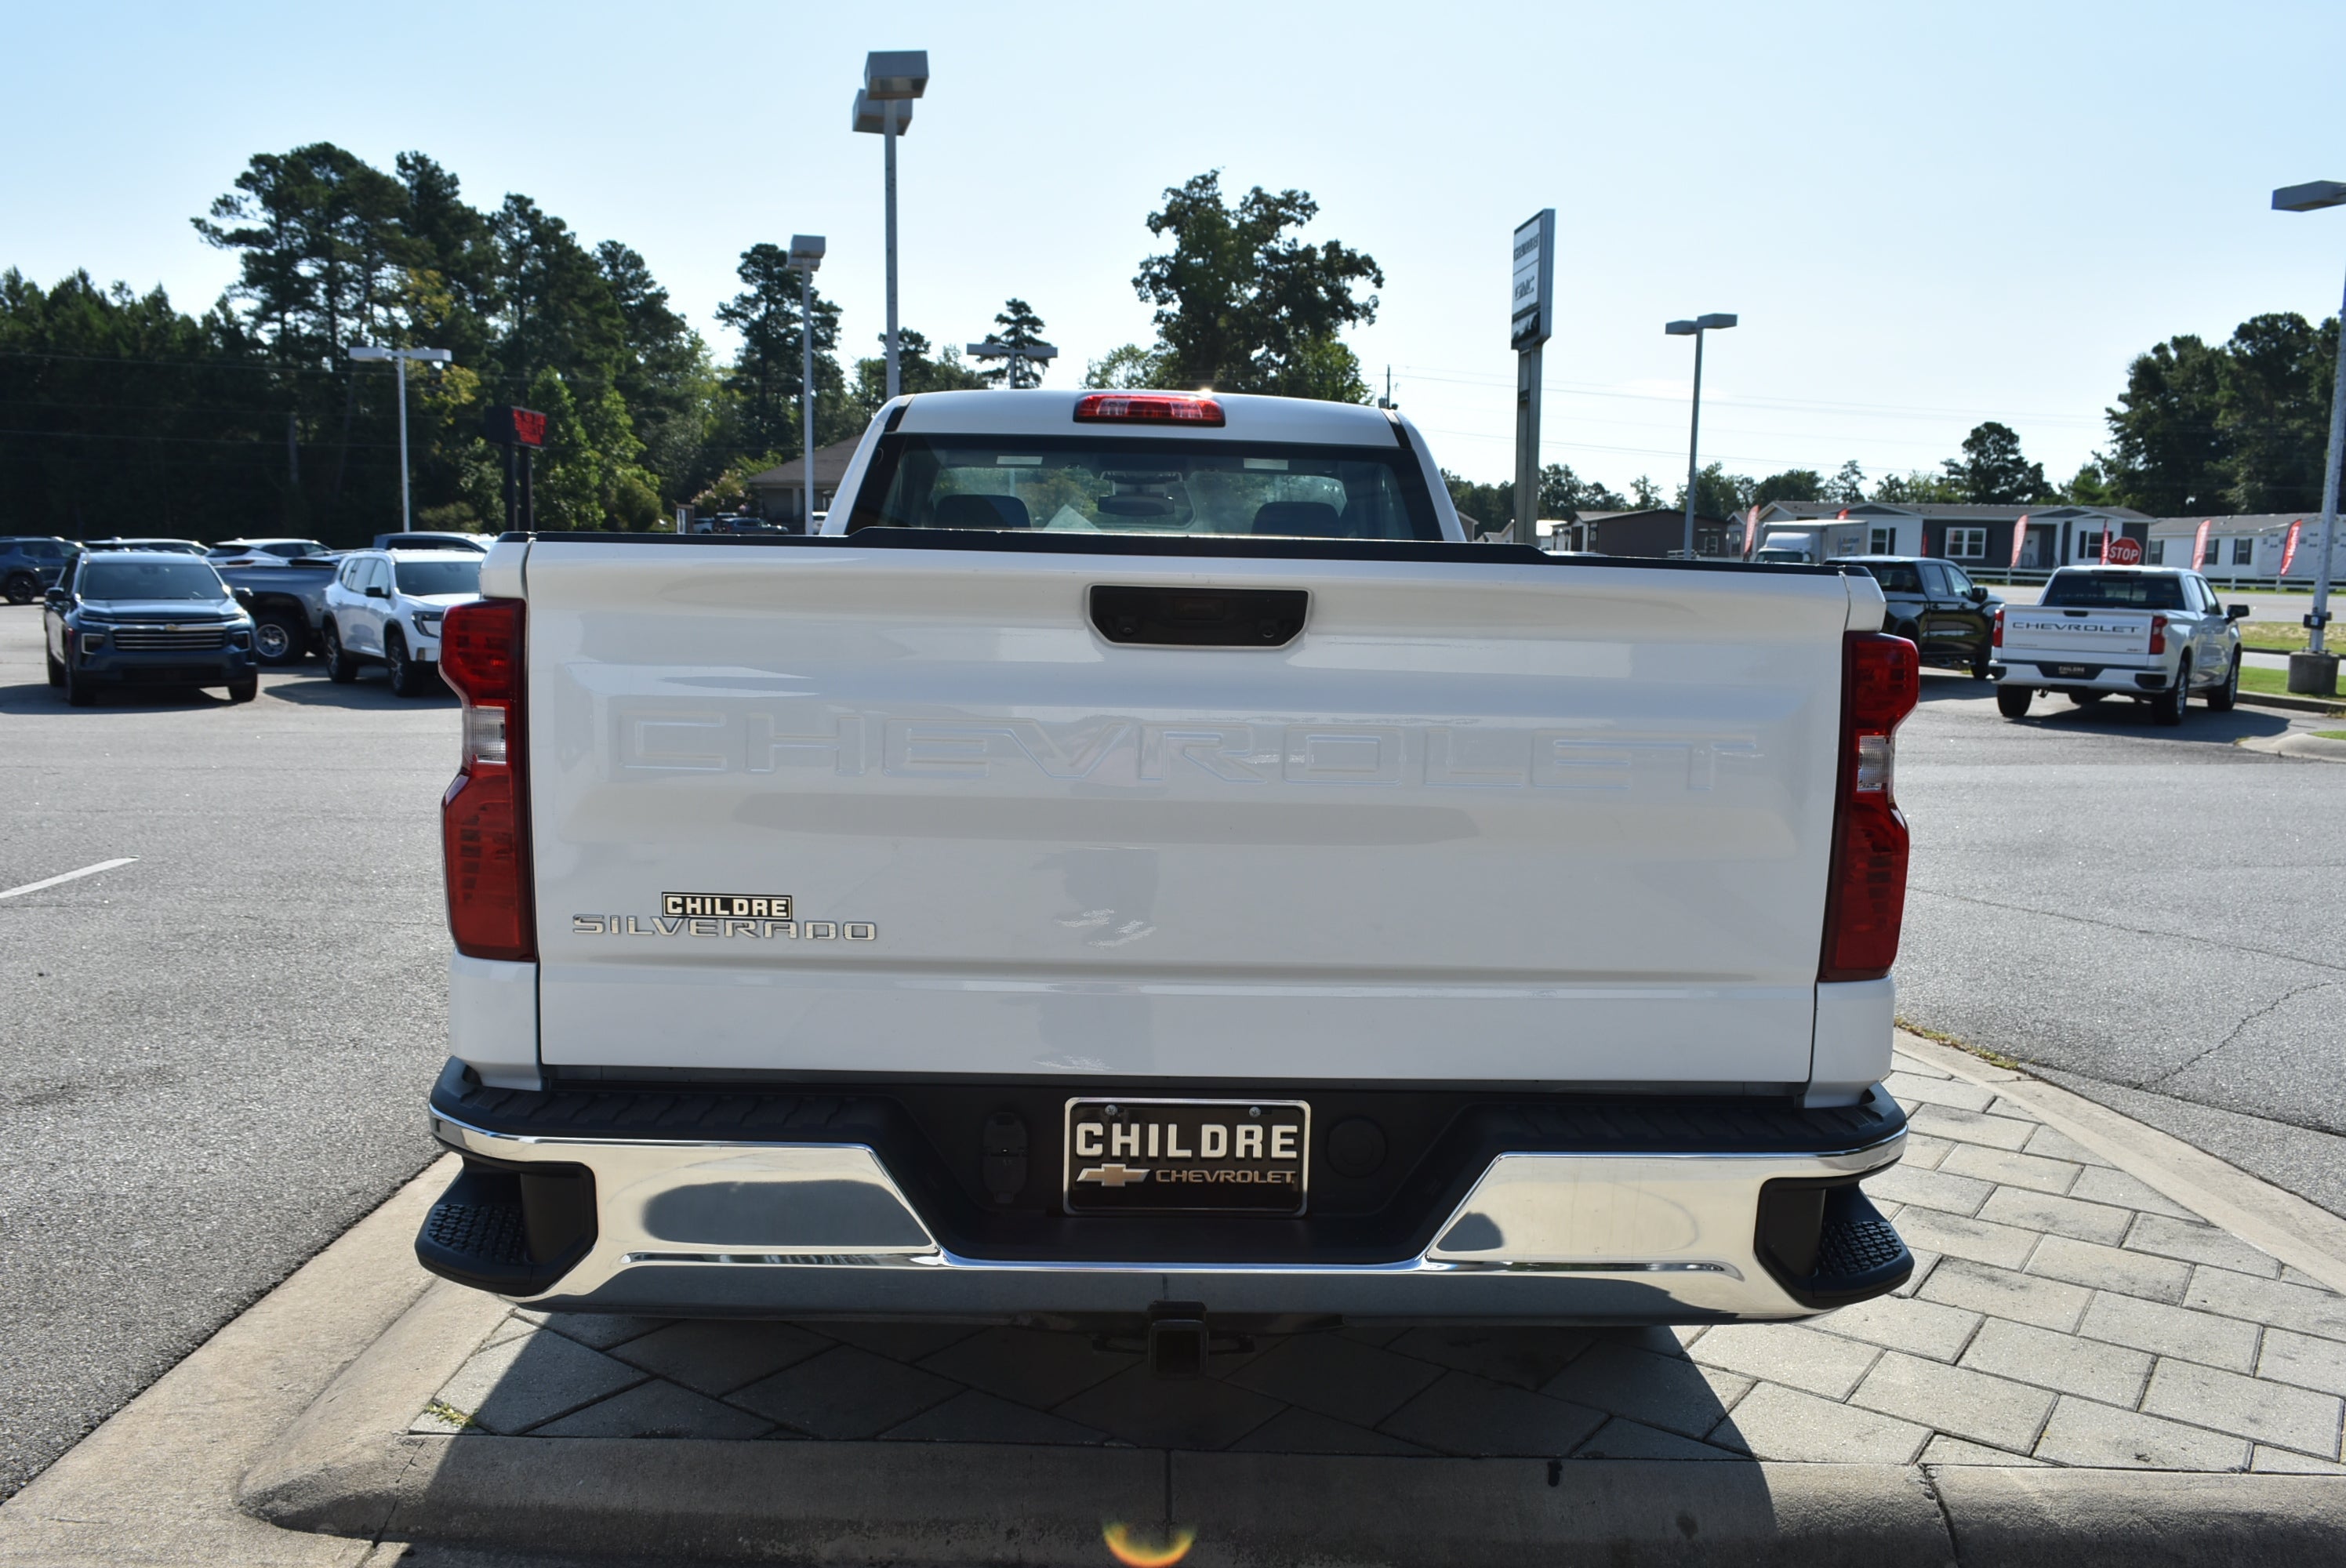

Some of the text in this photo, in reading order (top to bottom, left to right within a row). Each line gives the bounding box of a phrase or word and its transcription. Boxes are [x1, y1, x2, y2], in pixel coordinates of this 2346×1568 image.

[2109, 546, 2139, 561] STOP
[2013, 622, 2140, 633] CHEVROLET
[619, 711, 1758, 792] CHEVROLET
[666, 896, 788, 917] CHILDRE
[572, 913, 878, 941] SILVERADO
[1076, 1123, 1298, 1160] CHILDRE
[1155, 1169, 1296, 1185] CHEVROLET
